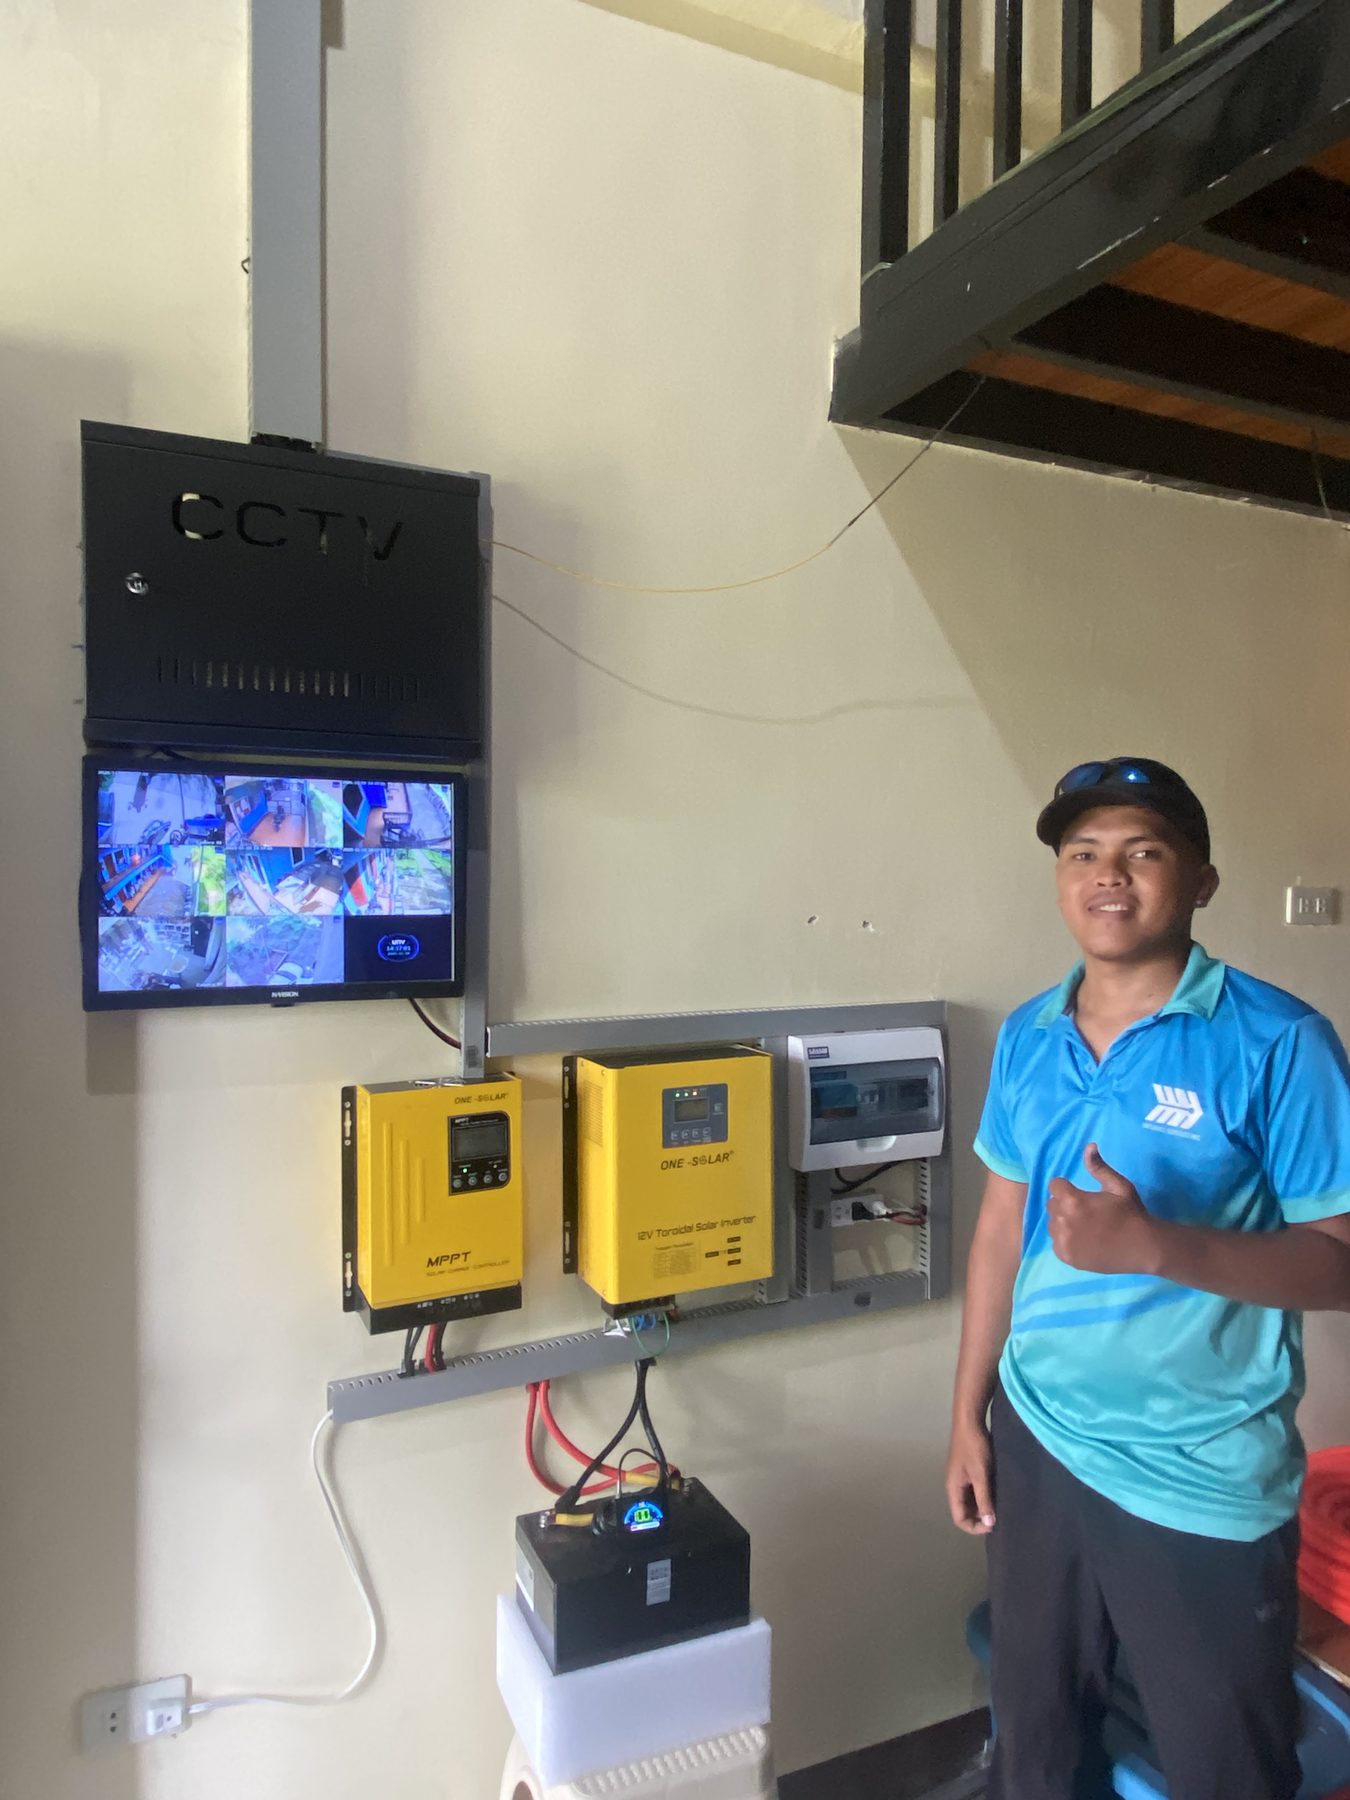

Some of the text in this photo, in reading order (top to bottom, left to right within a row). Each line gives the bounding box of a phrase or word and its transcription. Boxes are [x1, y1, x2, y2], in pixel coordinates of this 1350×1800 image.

[171, 492, 402, 562] CCTV
[656, 1223, 694, 1238] Toroidal
[695, 1221, 719, 1232] Solar
[720, 1215, 756, 1228] Inverter
[426, 1251, 472, 1269] MPPT
